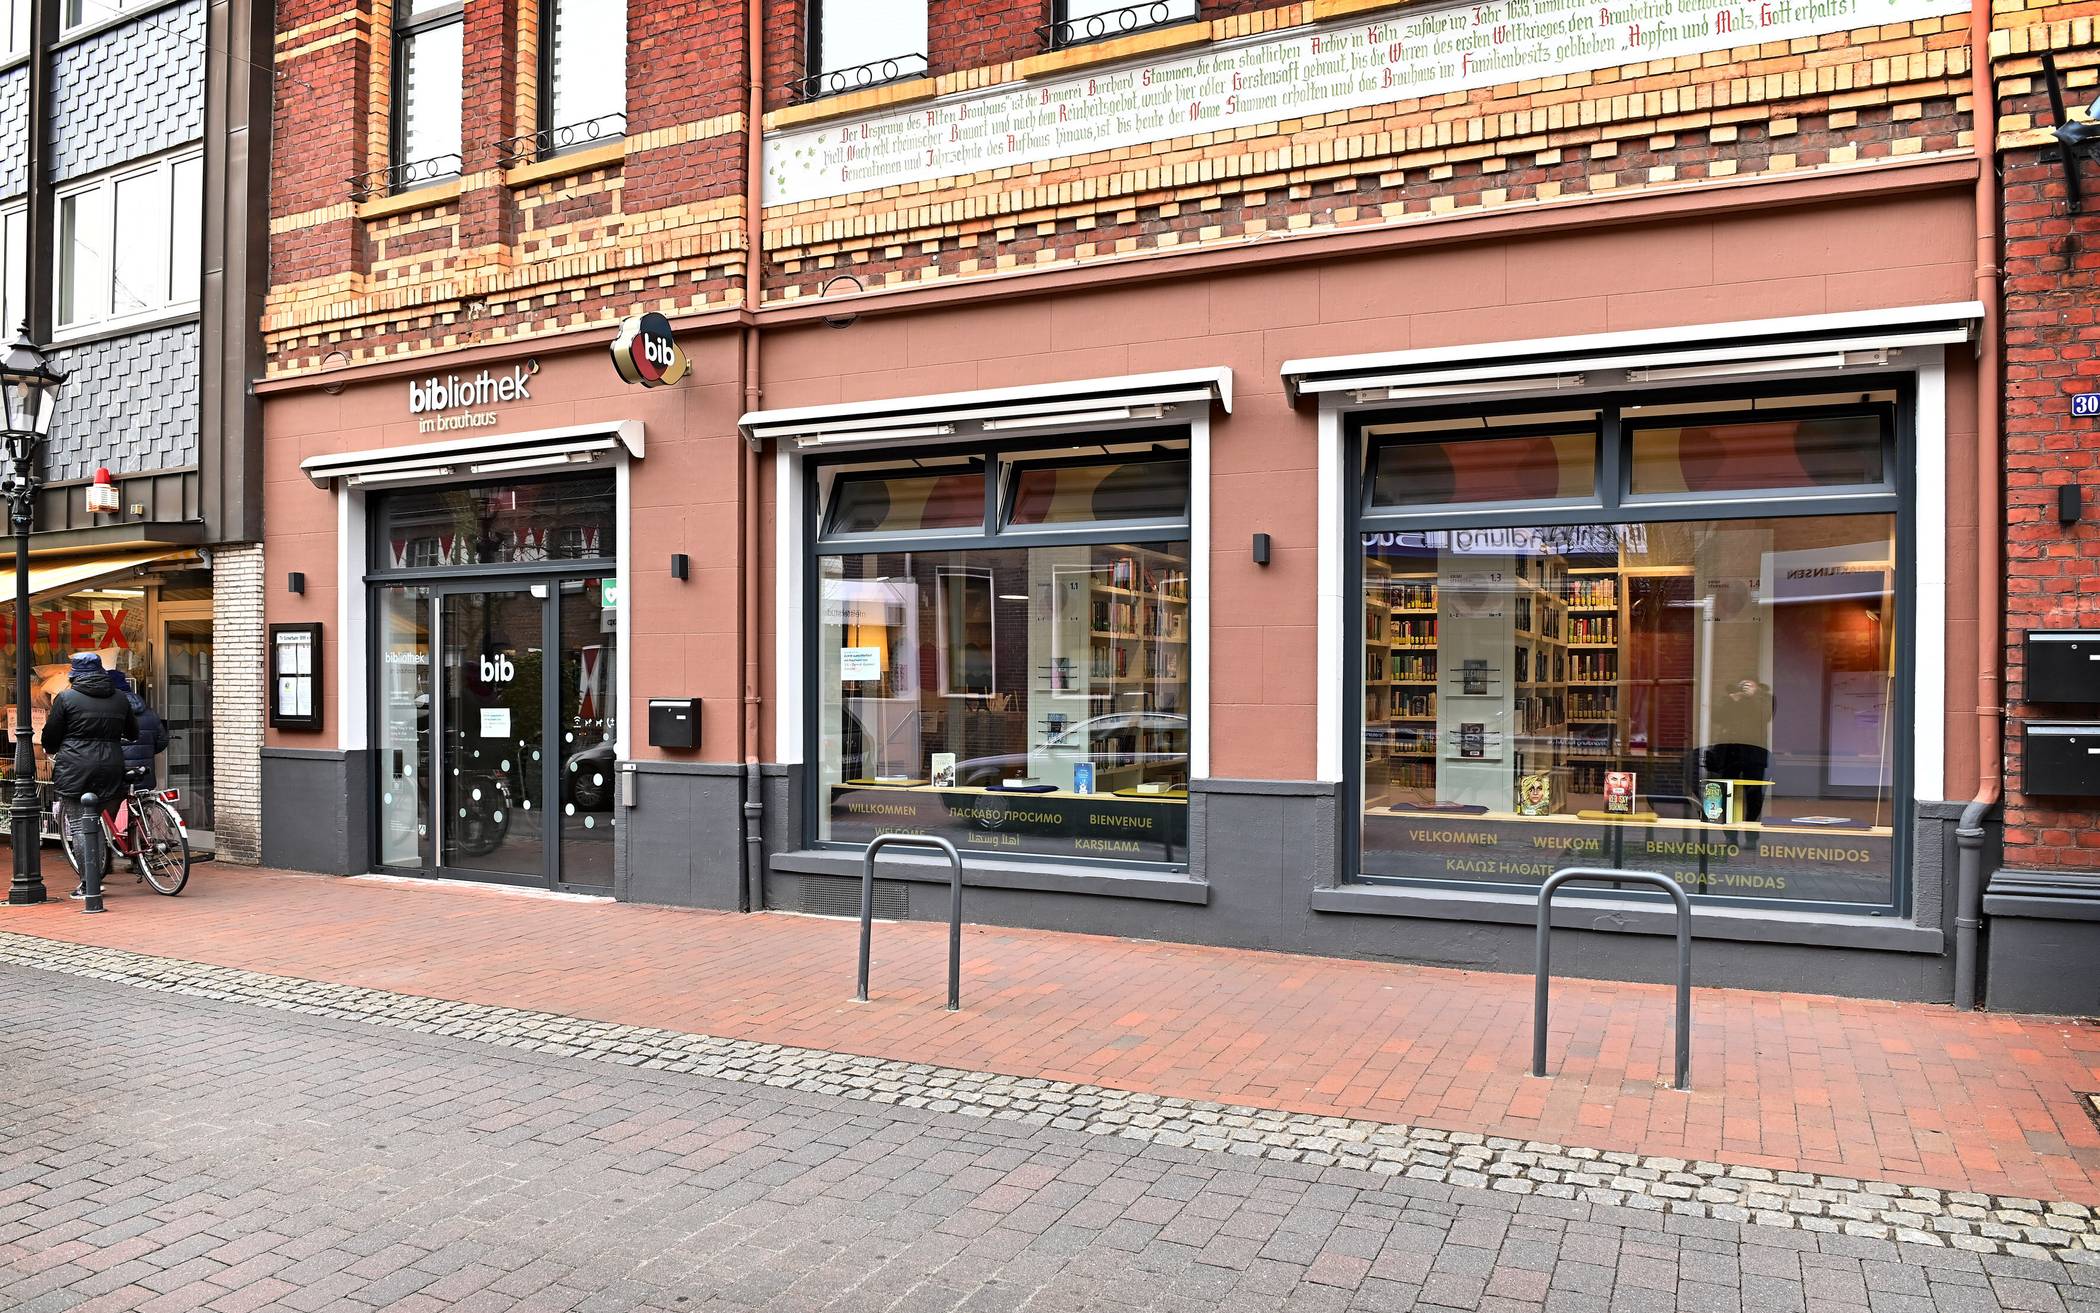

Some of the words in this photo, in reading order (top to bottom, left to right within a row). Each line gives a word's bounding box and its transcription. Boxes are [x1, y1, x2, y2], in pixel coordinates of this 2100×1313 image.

[840, 127, 858, 144] Der
[861, 122, 904, 140] Ursprung
[906, 114, 921, 130] des
[1025, 91, 1038, 107] die
[1040, 84, 1082, 105] Brauerei
[1088, 72, 1134, 97] Burchard
[1143, 66, 1197, 87] Stammen,
[1196, 57, 1210, 75] die
[1213, 54, 1236, 74] dem
[1239, 44, 1300, 70] staatlichen
[1311, 33, 1348, 56] Archiv
[1350, 32, 1364, 50] in
[1367, 23, 1398, 45] Köln
[1403, 16, 1447, 41] zufolge
[1447, 13, 1468, 31] im
[1471, 5, 1501, 26] Jahr
[847, 145, 871, 162] Nach
[872, 141, 889, 160] echt
[892, 131, 944, 155] rheinischer
[948, 121, 988, 143] Brauart
[991, 114, 1010, 135] und
[1014, 113, 1037, 132] nach
[1038, 109, 1056, 127] dem
[1060, 91, 1140, 123] Reinheitsgebot,
[1141, 85, 1173, 107] wurde
[1175, 83, 1197, 105] hier
[1199, 76, 1226, 97] edler
[1232, 60, 1300, 92] Gerstensaft
[1302, 53, 1349, 81] gebraut,
[1351, 51, 1368, 71] bis
[1370, 46, 1386, 67] die
[1389, 42, 1429, 63] Wirren
[1433, 37, 1453, 57] des
[1456, 30, 1491, 52] ersten
[1493, 18, 1568, 45] Weltkrieges,
[1568, 12, 1594, 33] den
[1599, 0, 1673, 27] Braubetrieb
[841, 160, 902, 183] Generationen
[904, 154, 922, 171] und
[926, 143, 982, 168] Jahrzehnte
[986, 139, 1004, 157] des
[1007, 132, 1051, 156] Aufbaus
[1055, 126, 1097, 149] hinaus,
[1096, 119, 1111, 138] ist
[1116, 116, 1132, 134] bis
[1135, 109, 1164, 132] heute
[1168, 105, 1186, 126] der
[1190, 101, 1221, 122] Name
[1225, 94, 1277, 115] Stammen
[1282, 80, 1328, 108] erhalten
[1331, 74, 1354, 97] und
[1358, 71, 1378, 93] das
[1380, 62, 1437, 89] Brauhaus
[1437, 61, 1455, 79] im
[1462, 41, 1552, 79] Familienbesitz
[1555, 32, 1615, 63] geblieben
[1682, 13, 1709, 40] und
[1716, 8, 1757, 35] Malz,
[1761, 0, 1792, 27] Gott
[645, 332, 675, 367] bib
[409, 365, 530, 414] bibliothek
[2076, 395, 2099, 414] 30
[419, 417, 435, 433] im
[437, 409, 497, 432] brauhaus
[0, 610, 129, 650] TEX
[385, 651, 425, 664] bibliothek
[480, 653, 515, 682] bib
[848, 803, 916, 816] WILLKOMMEN
[949, 807, 1001, 821] ЛАСКАВО
[1004, 811, 1062, 825] ПРОСИМО
[1089, 814, 1153, 828] BIENVENUE
[1409, 830, 1497, 845] VELKOMMEN
[1533, 836, 1599, 850] WELKOM
[1646, 841, 1740, 857] BENVENUTO
[1760, 845, 1870, 863] BIENVENIDOS
[1674, 871, 1786, 889] BOAS-VINDAS
